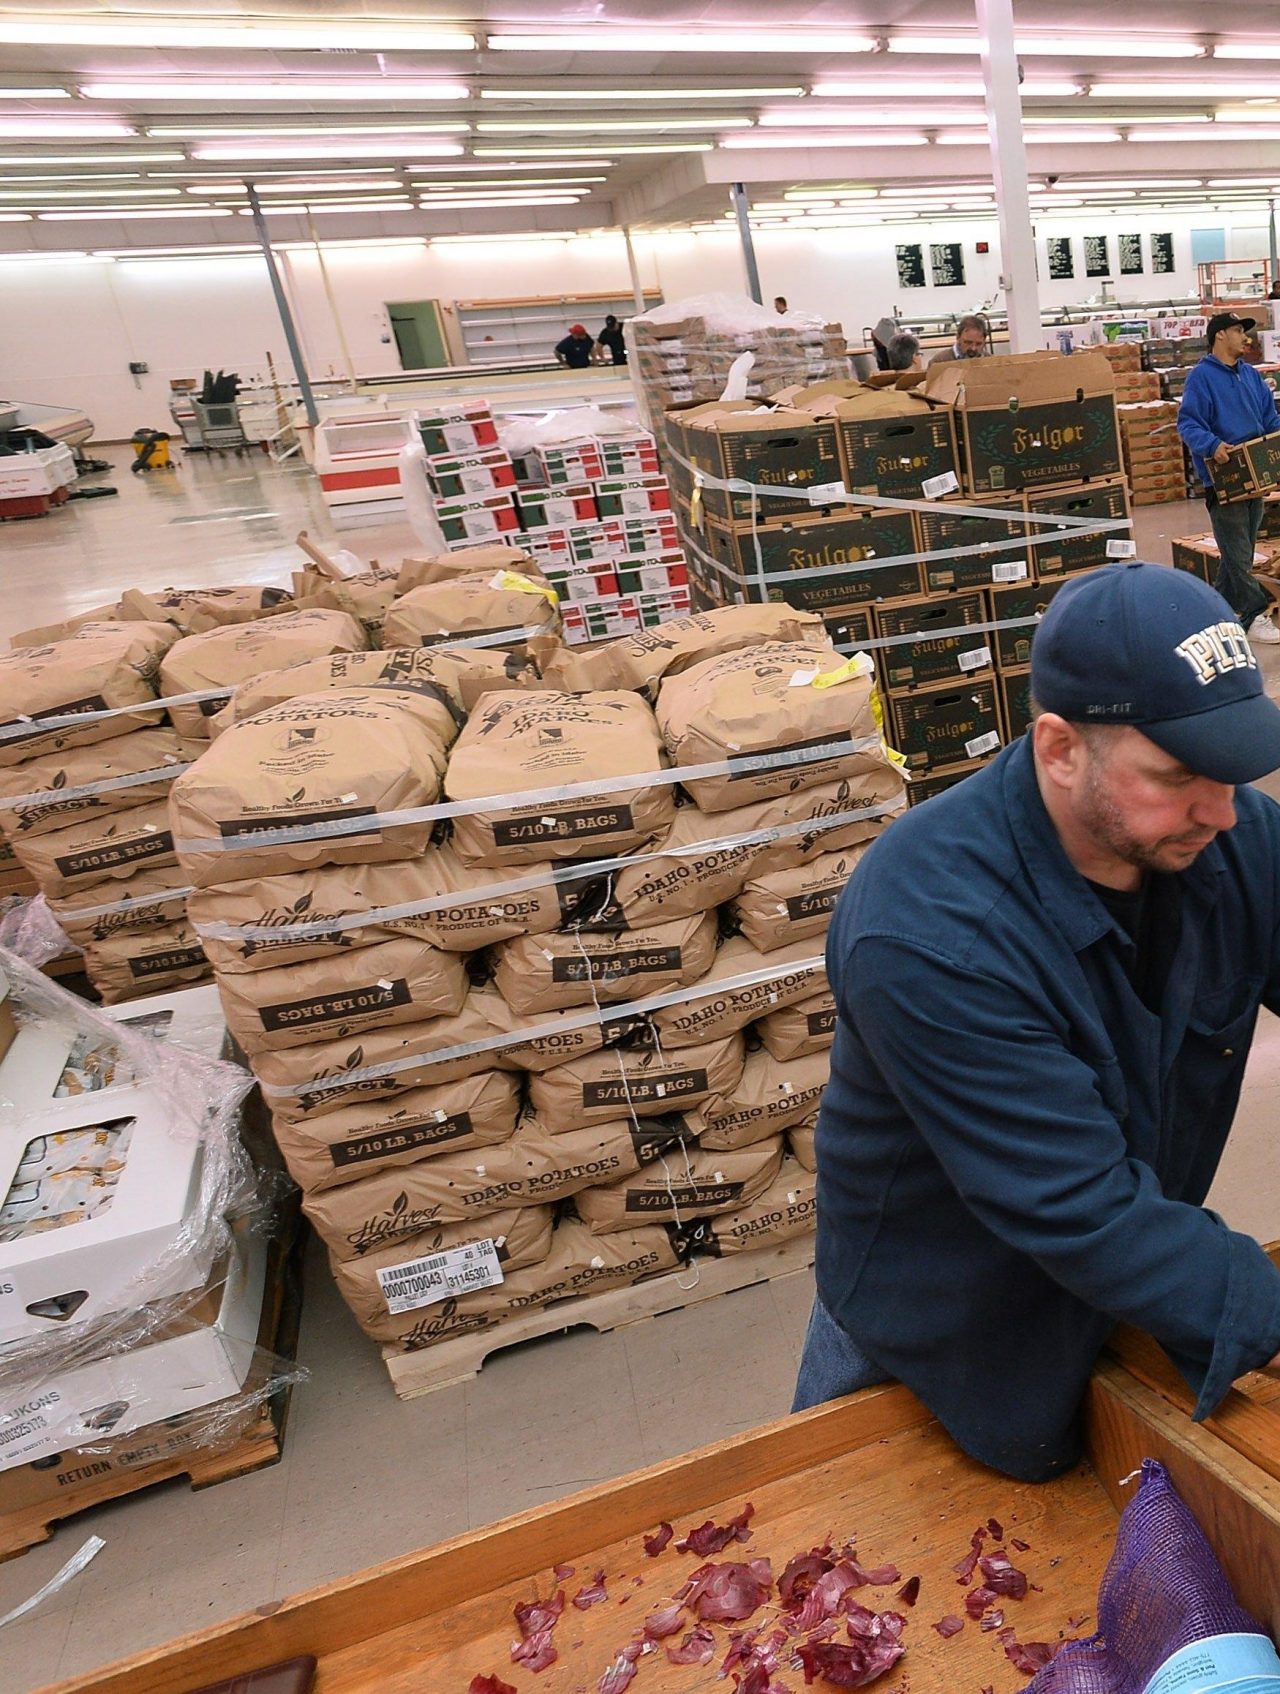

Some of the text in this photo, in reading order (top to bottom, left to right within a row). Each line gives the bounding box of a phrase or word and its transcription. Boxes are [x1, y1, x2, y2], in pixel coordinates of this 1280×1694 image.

[1012, 424, 1084, 454] Fulgor
[1021, 464, 1081, 478] VEGETABLES
[803, 583, 872, 600] VEGETABLES
[1174, 621, 1257, 686] PITT
[26, 799, 91, 821] SELECT
[807, 793, 878, 820] Harvest
[510, 814, 618, 838] 5/10 LB. BAGS
[69, 840, 164, 869] 5/10 LB. BAGS
[632, 866, 690, 899] IDAHO
[698, 862, 738, 882] PRODUCE
[437, 900, 540, 922] POTATOES
[800, 896, 829, 911] 5/10
[141, 958, 169, 969] 5/10
[567, 955, 668, 975] 5/10 LB. BAGS
[326, 997, 356, 1012] LB.
[358, 990, 394, 1008] 5/10
[672, 968, 815, 1030] IDAHO POTATOES
[277, 1005, 325, 1022] BAGS
[597, 1086, 654, 1099] 5/10 LB.
[711, 1083, 828, 1130] IDAHO POTATO
[347, 1123, 457, 1156] 5/10 LB. BAGS
[460, 1156, 620, 1206] IDAHO POTATOES
[639, 1195, 668, 1205] 5/10
[696, 1188, 732, 1201] BAGS
[347, 1203, 442, 1243] Harvest
[731, 1212, 783, 1237] IDAHO
[476, 1240, 490, 1250] LOT
[479, 1248, 493, 1258] TAG
[382, 1266, 491, 1298] 0000700043 31145301
[507, 1252, 660, 1308] IDAHO POTATOES
[8, 1391, 61, 1421] UKONS
[56, 1461, 112, 1486] RETURN
